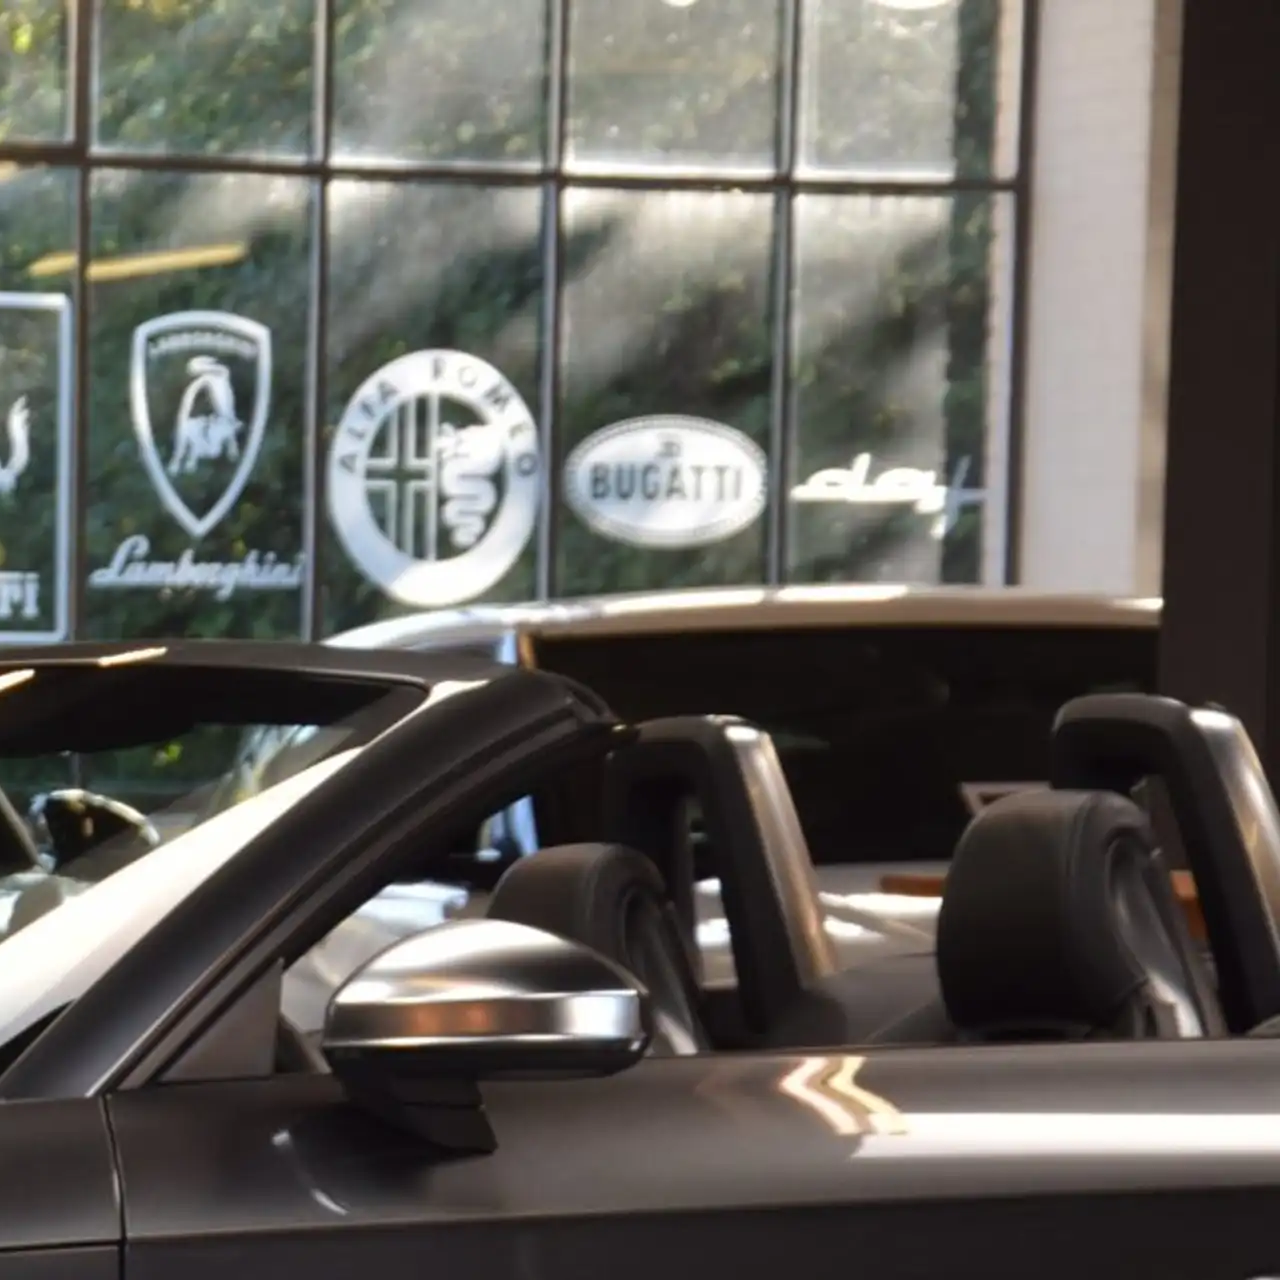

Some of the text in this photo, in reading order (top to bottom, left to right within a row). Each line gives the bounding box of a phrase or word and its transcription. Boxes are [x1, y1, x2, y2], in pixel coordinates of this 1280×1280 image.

[340, 357, 540, 477] ALFA ROMEO
[590, 462, 742, 499] BUGATTI
